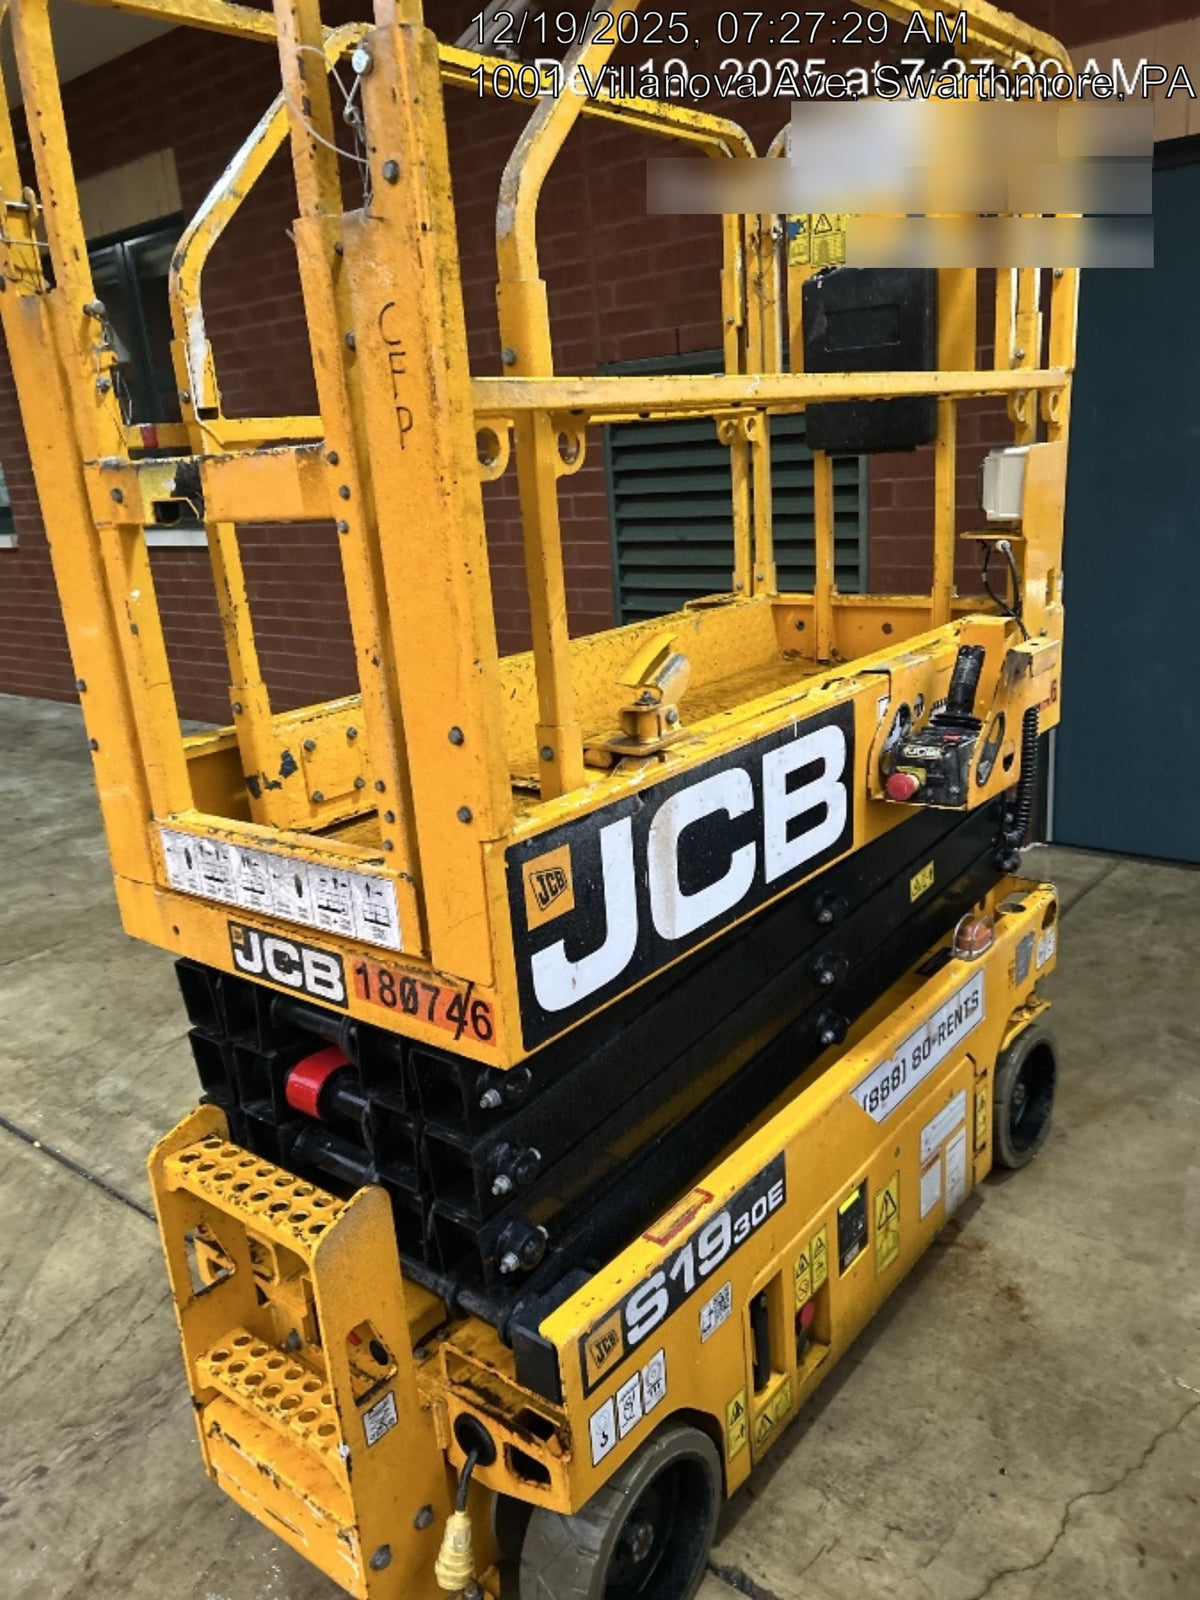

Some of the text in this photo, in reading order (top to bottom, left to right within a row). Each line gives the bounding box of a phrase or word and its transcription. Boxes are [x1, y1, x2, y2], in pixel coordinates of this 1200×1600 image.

[531, 724, 847, 1012] JCB
[535, 870, 565, 906] JCB
[234, 931, 344, 1002] JCB
[911, 990, 979, 1071] 80-RENTS
